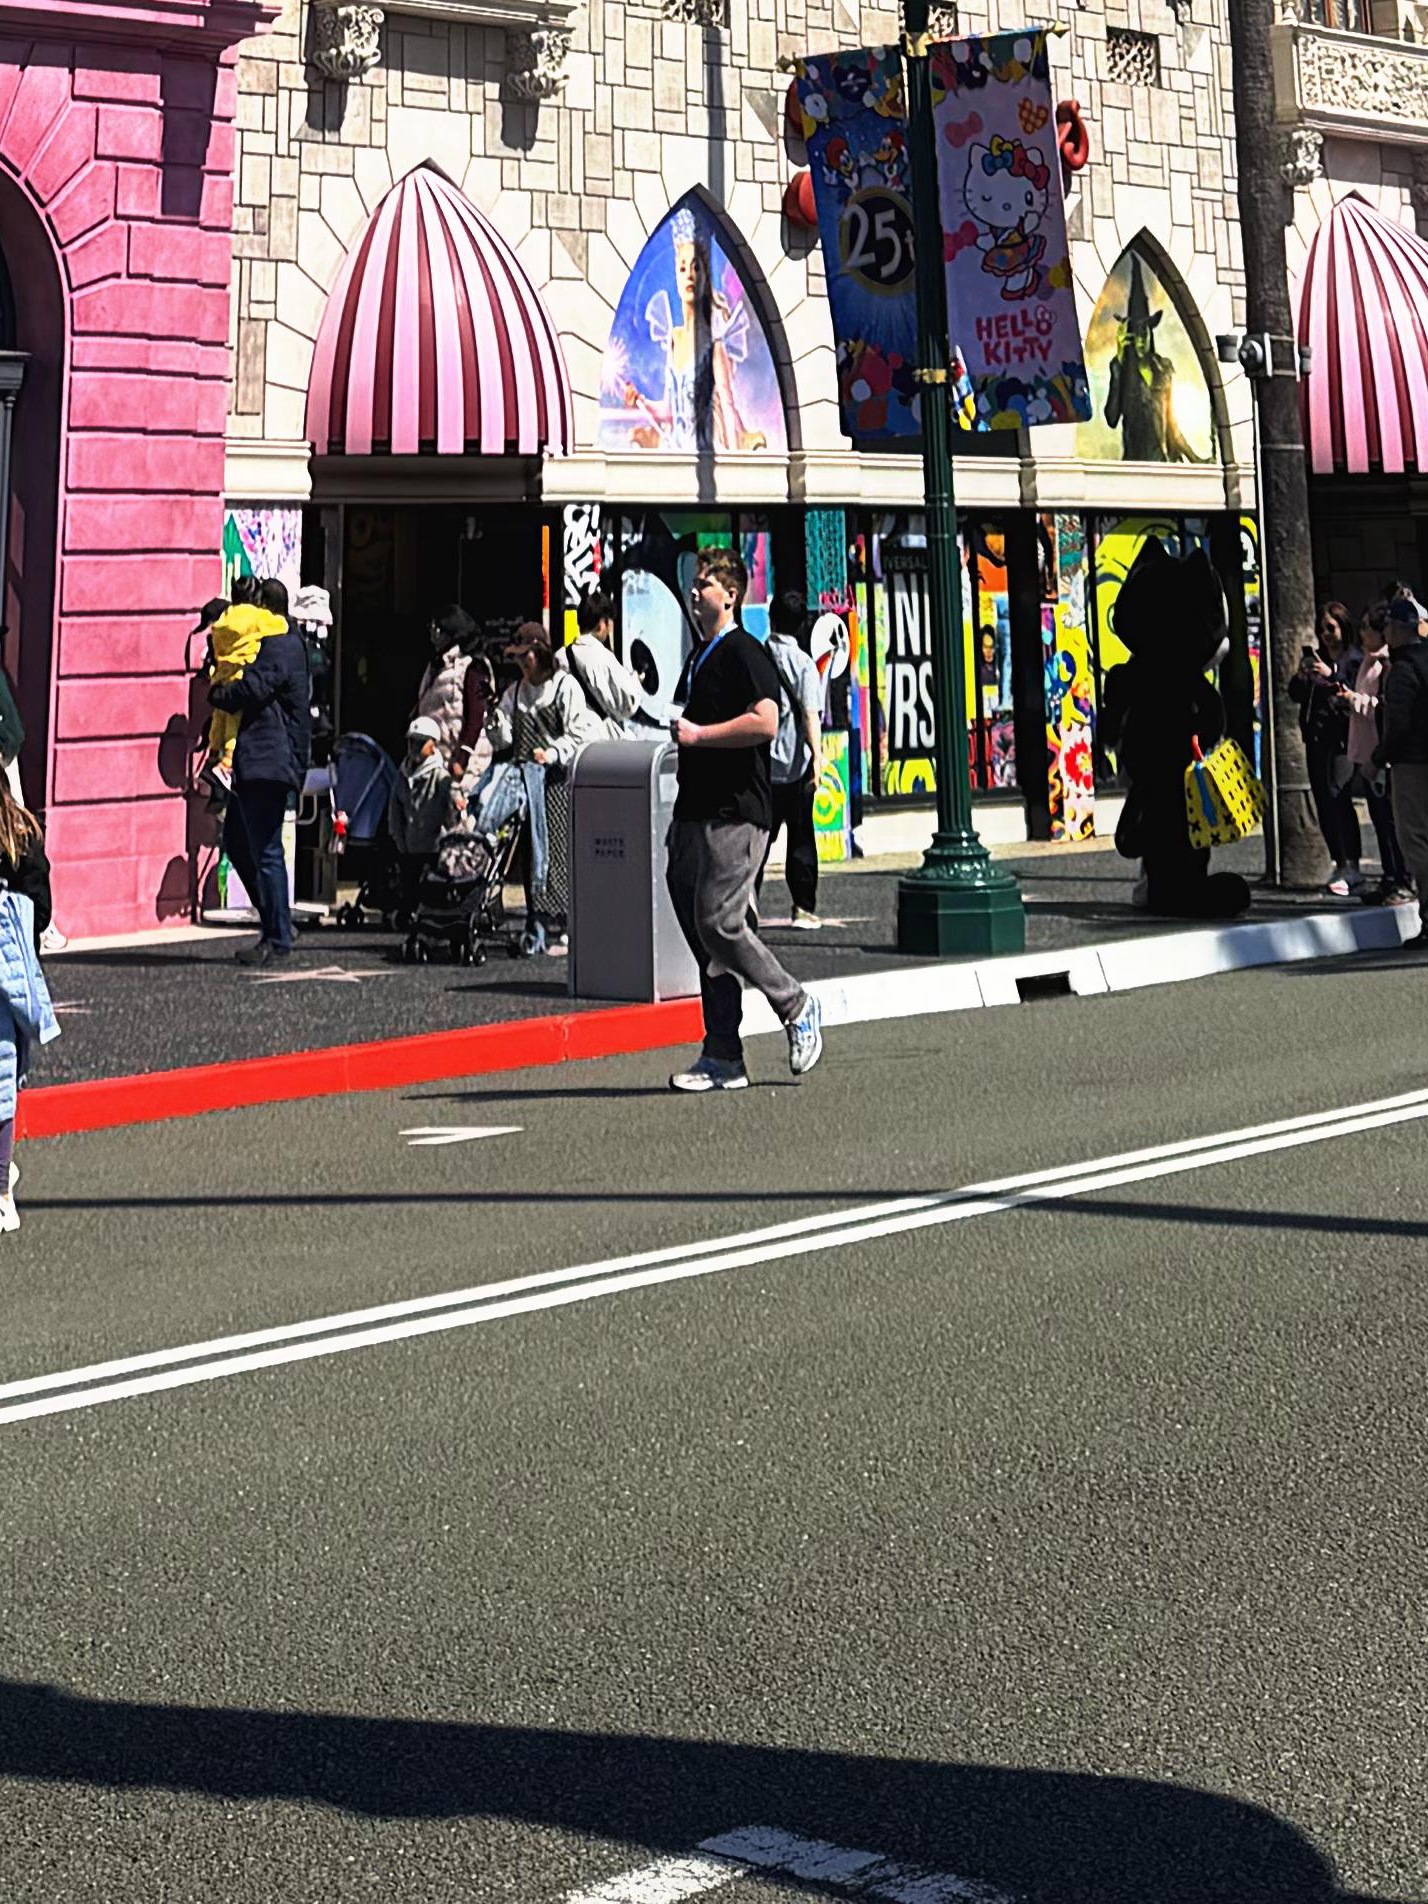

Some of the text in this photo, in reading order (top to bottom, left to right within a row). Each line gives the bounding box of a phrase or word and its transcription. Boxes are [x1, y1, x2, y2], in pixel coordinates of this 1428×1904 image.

[843, 202, 915, 279] 25t
[975, 306, 1055, 341] HELLO
[983, 337, 1053, 367] KITTY
